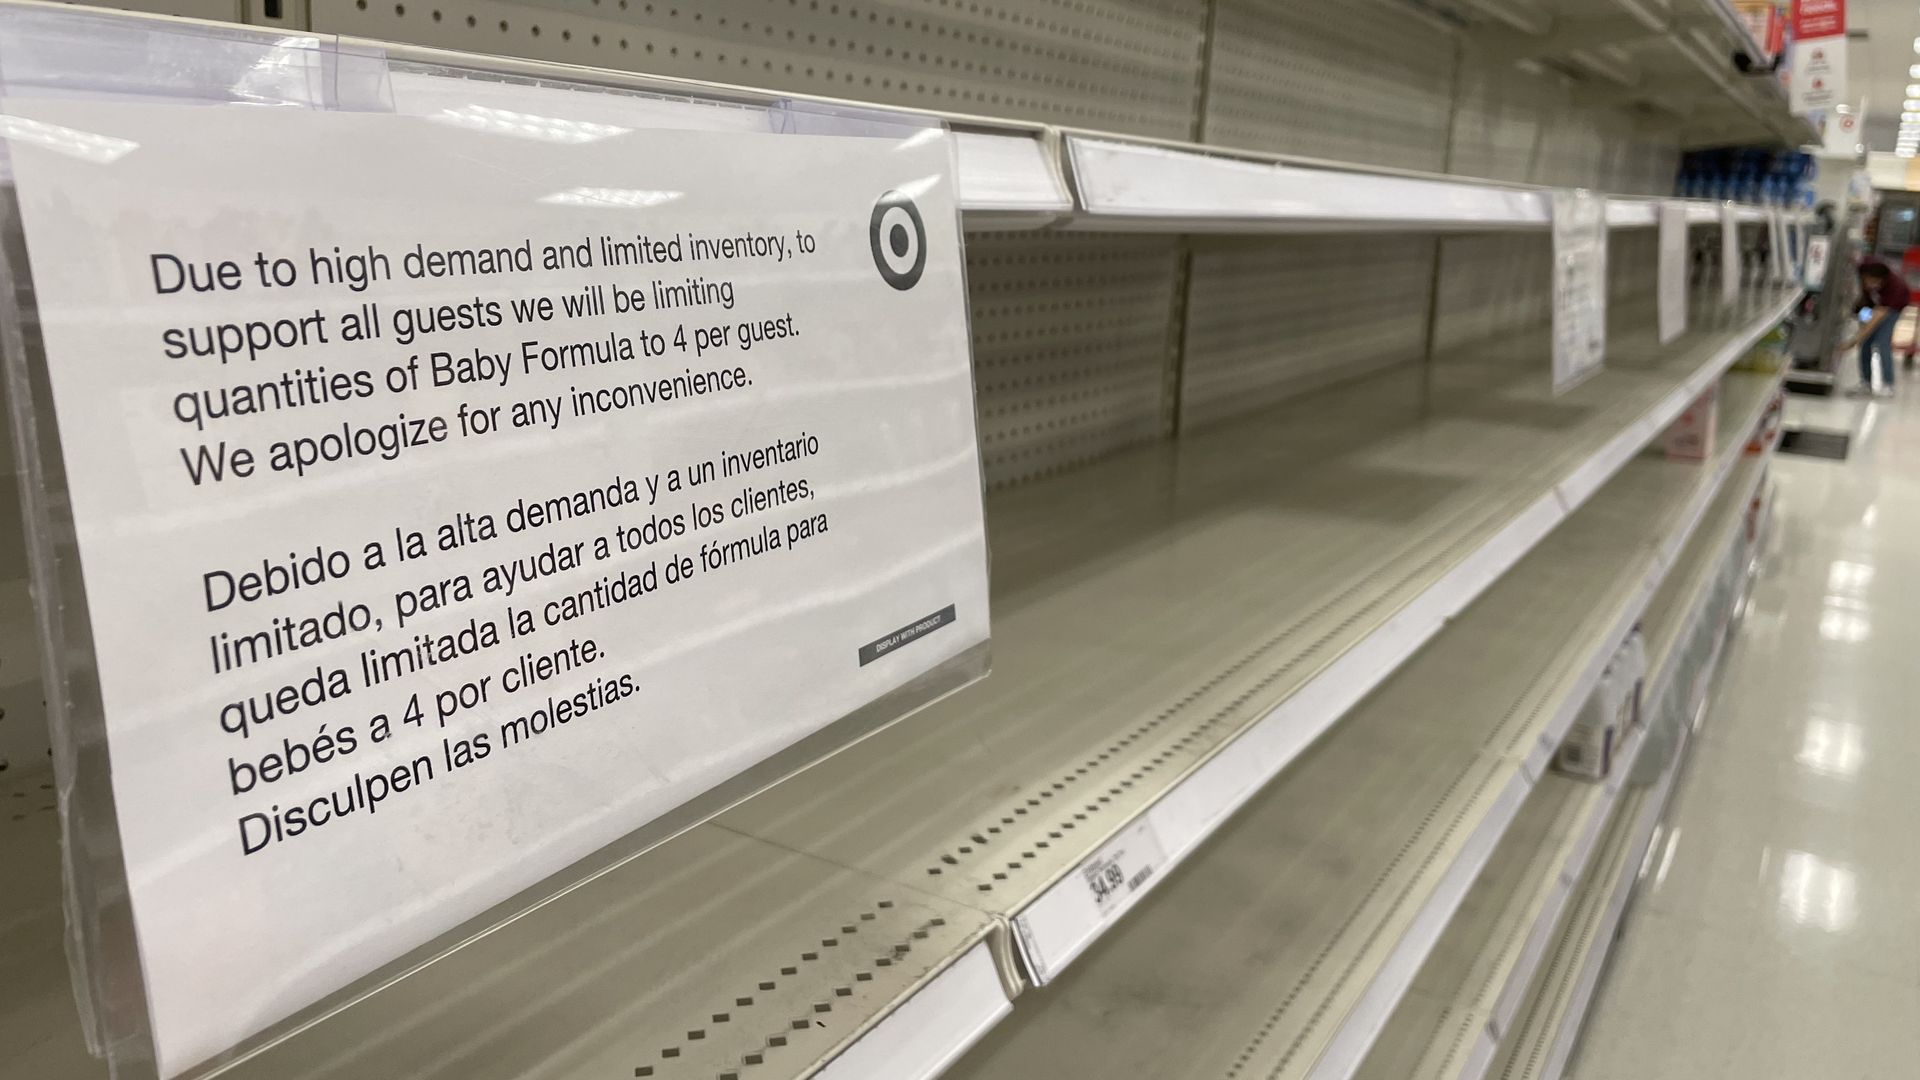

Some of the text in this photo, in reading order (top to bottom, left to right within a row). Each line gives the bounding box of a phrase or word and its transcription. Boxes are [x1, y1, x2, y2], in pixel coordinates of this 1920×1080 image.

[149, 229, 816, 295] Due to high demand and limited inventory, to
[162, 276, 735, 365] support all guests we will be limiting
[173, 312, 800, 431] quantities of Baby Formula to 4 per guest.
[179, 366, 753, 486] We apologize for any inconvenience.
[202, 431, 819, 613] Debido a la alta demanda y a un inventario
[210, 478, 815, 675] limitado, para ayudar a todos los clientes,
[219, 513, 829, 739] queda limitada la cantidad de fórmula para
[876, 614, 941, 653] DISPLAY WITH PRODUCT
[228, 638, 605, 796] bebés a 4 por cliente.
[238, 673, 640, 857] Disculpen las molestias.
